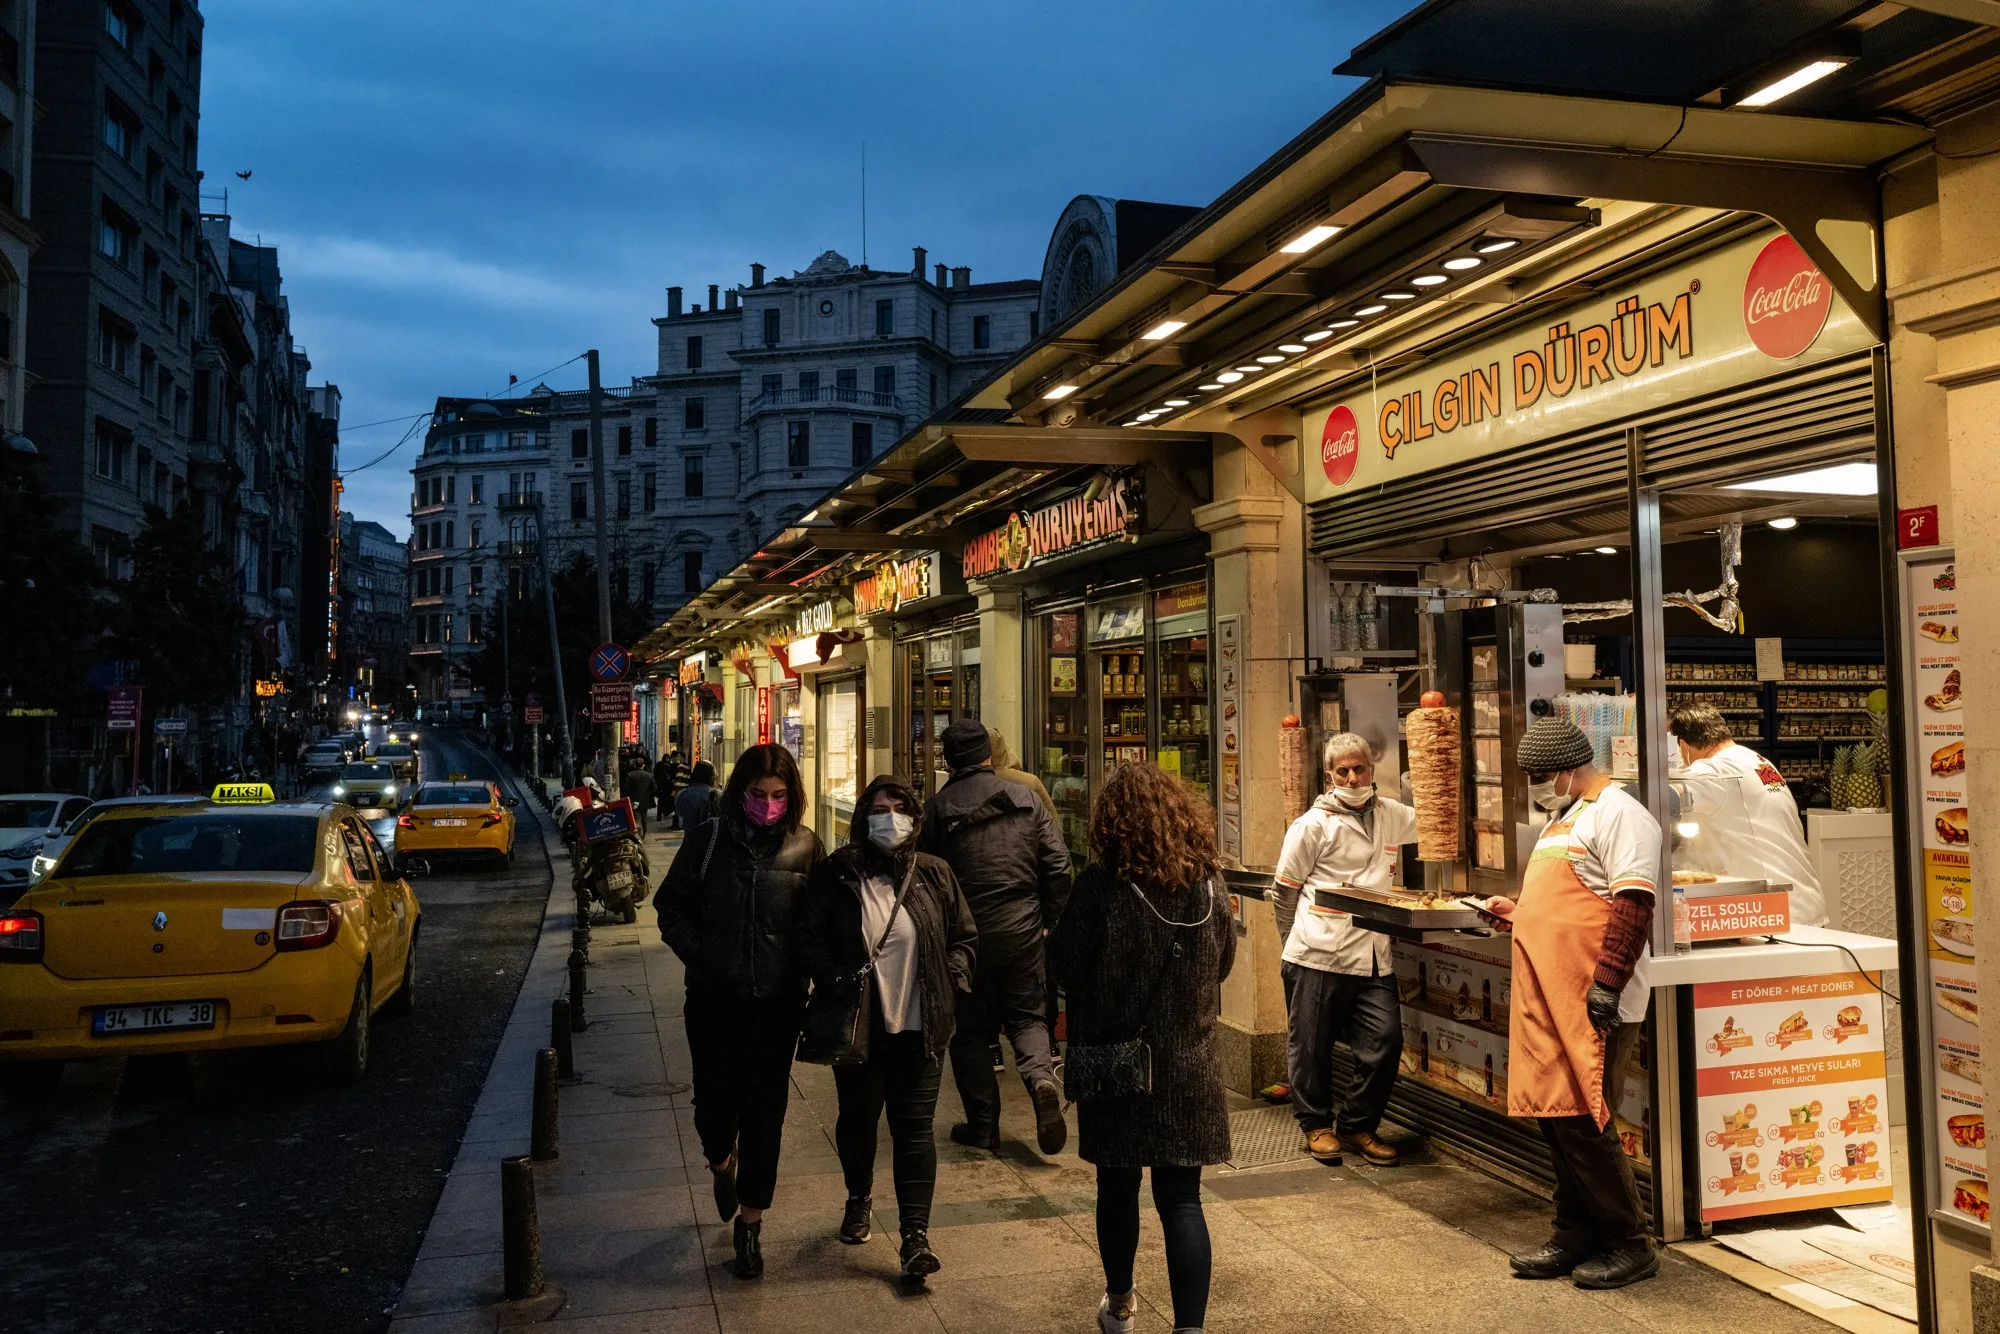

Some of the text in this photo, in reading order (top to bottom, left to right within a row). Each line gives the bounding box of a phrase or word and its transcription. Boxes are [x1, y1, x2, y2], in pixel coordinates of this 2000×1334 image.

[1379, 292, 1695, 460] ÇILGIN DÜRÜM
[813, 601, 833, 632] GOLD
[1059, 664, 1074, 672] TEA
[1945, 791, 1963, 799] DÖNER
[1935, 874, 1951, 882] TAVUK
[1719, 901, 1762, 916] SOSLU
[1701, 914, 1785, 932] HAMBURGER
[1731, 989, 1745, 1000] ET
[1746, 985, 1782, 999] DÖNER
[1791, 984, 1819, 996] MEAT
[1819, 981, 1855, 994] DONER
[106, 1009, 127, 1028] 34
[141, 1006, 175, 1026] TKC
[189, 1004, 210, 1023] 38
[1730, 1058, 1861, 1081] TAZE SIKMA MEYVE SULARI
[1772, 1074, 1817, 1086] FRESH JUICE
